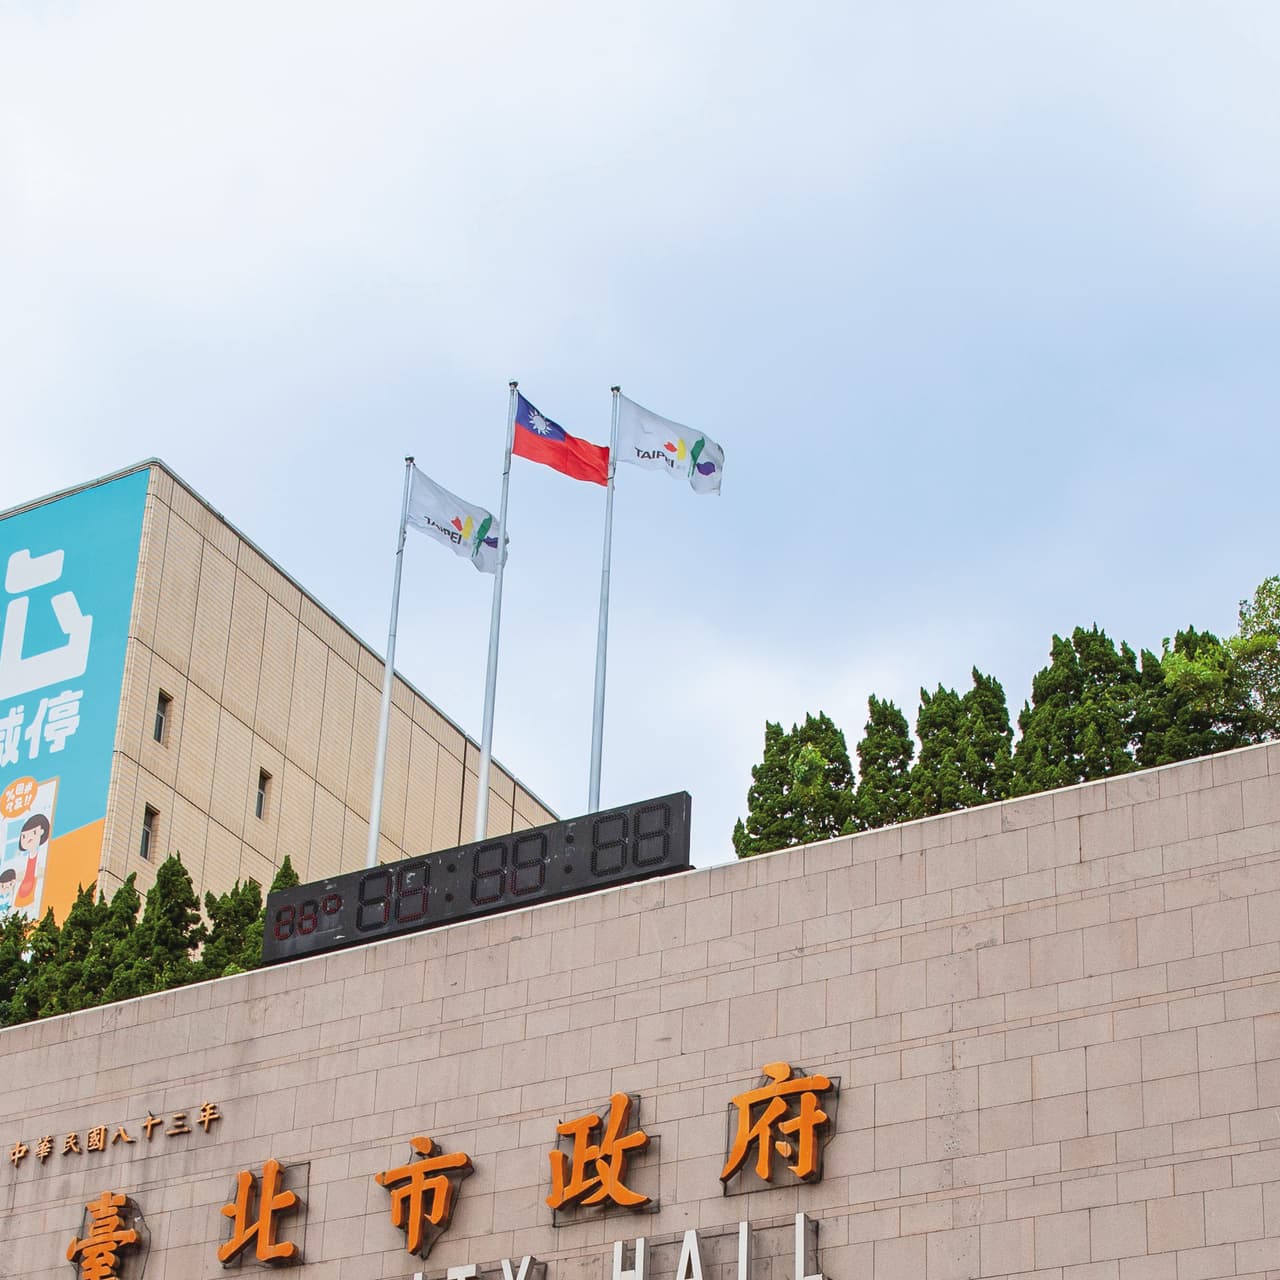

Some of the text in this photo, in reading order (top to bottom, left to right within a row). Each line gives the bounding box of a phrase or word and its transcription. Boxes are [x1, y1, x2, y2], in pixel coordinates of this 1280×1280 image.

[9, 1101, 221, 1168] 中華民國八十三年
